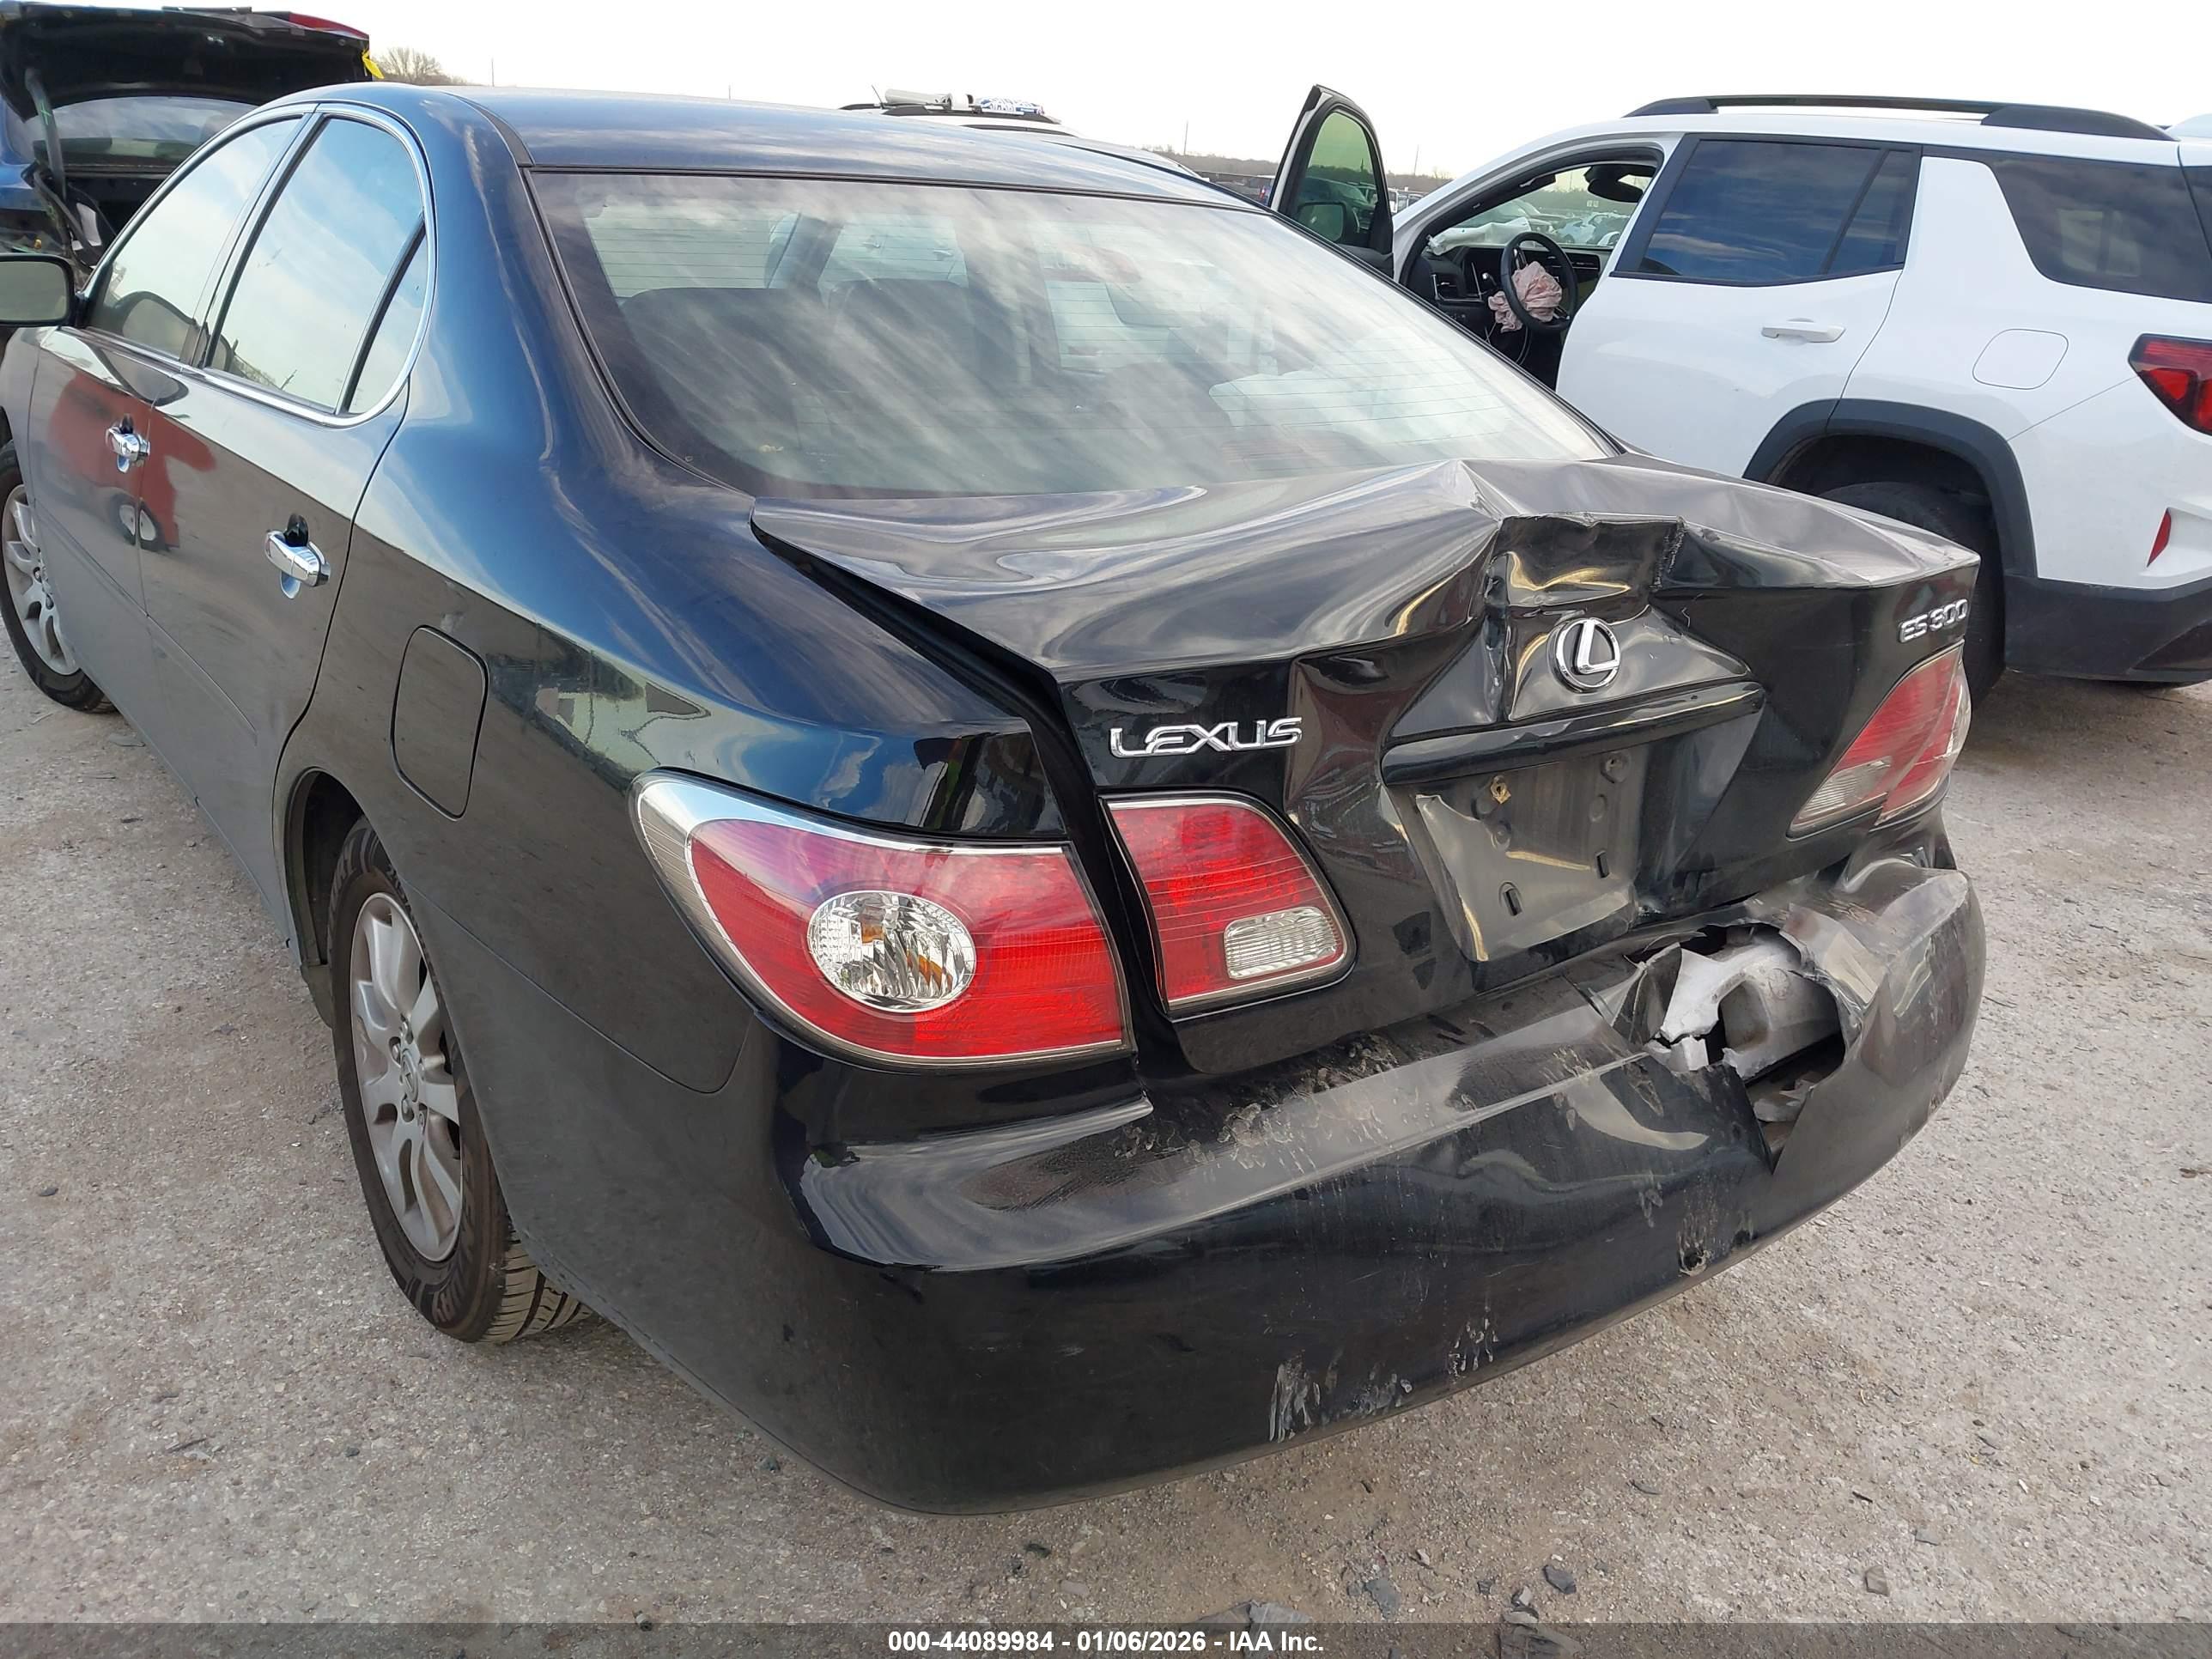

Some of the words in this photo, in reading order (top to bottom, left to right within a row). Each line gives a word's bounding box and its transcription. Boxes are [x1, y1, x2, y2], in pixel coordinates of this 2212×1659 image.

[1899, 614, 1928, 642] ES
[1929, 599, 1968, 631] 300
[1110, 716, 1303, 757] LEXUS
